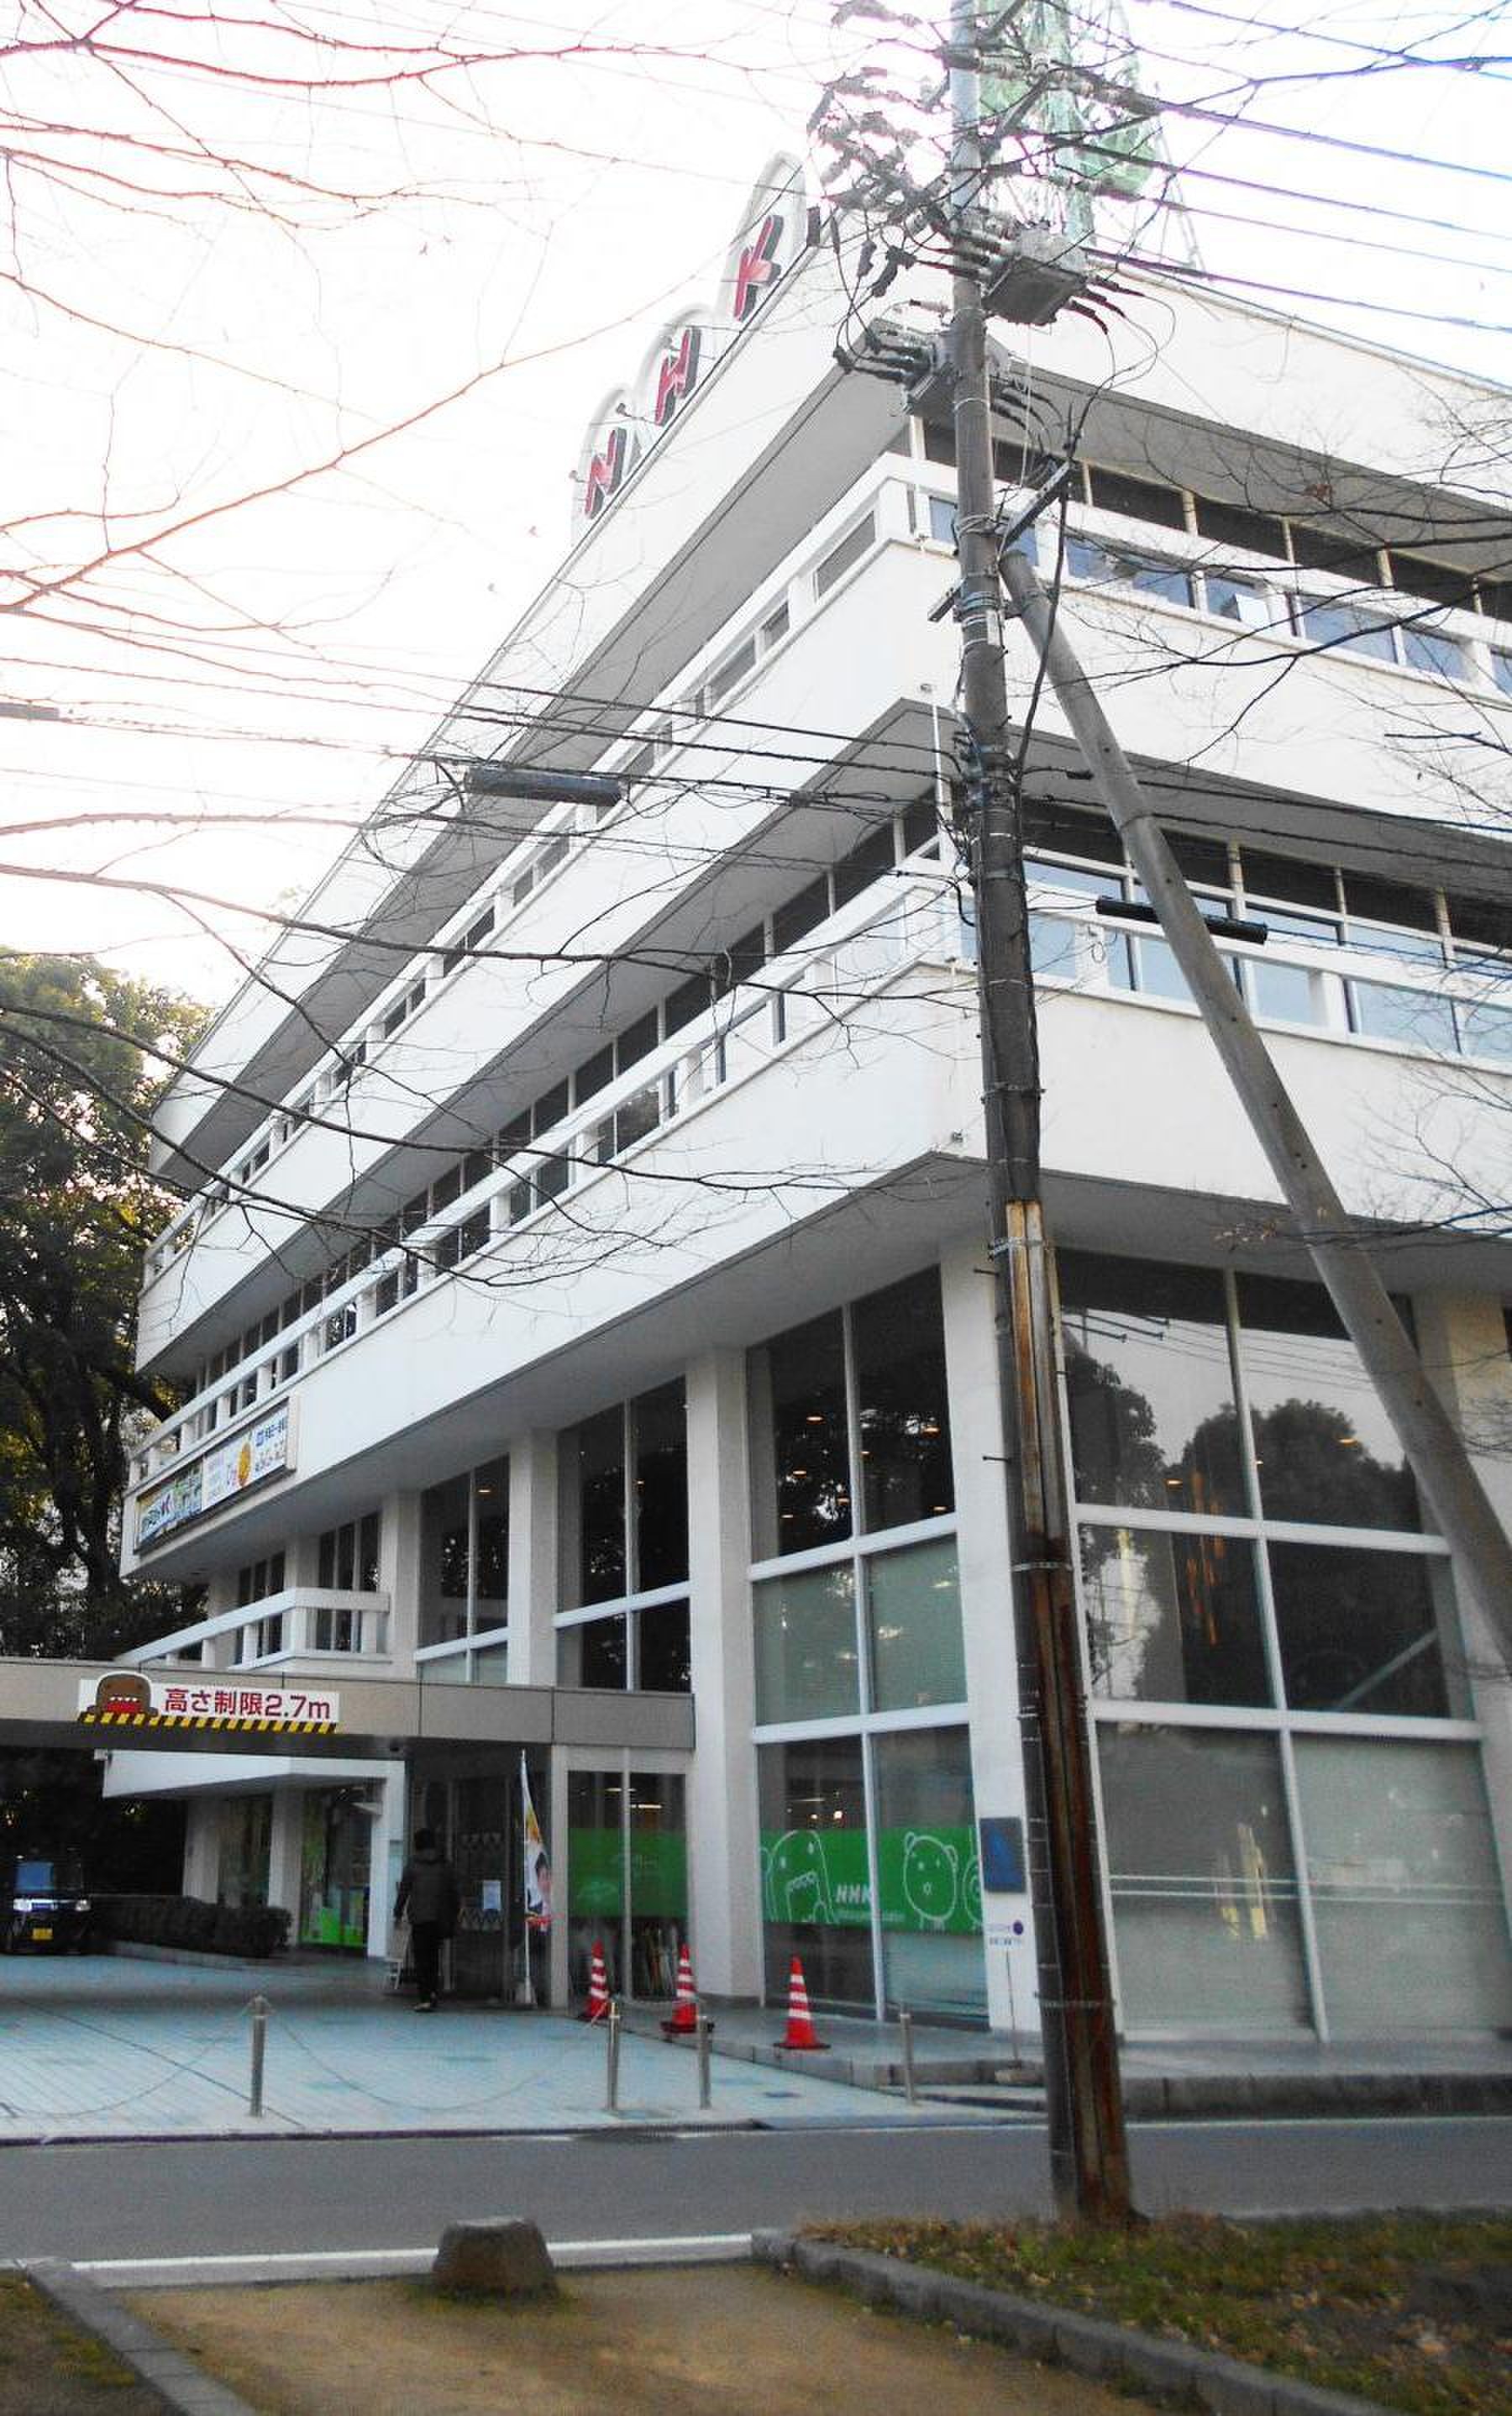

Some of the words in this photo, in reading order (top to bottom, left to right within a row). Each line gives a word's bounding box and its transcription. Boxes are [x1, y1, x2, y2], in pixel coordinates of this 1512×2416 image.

[585, 214, 784, 520] NHK
[165, 1688, 330, 1719] 高さ制限2.7m
